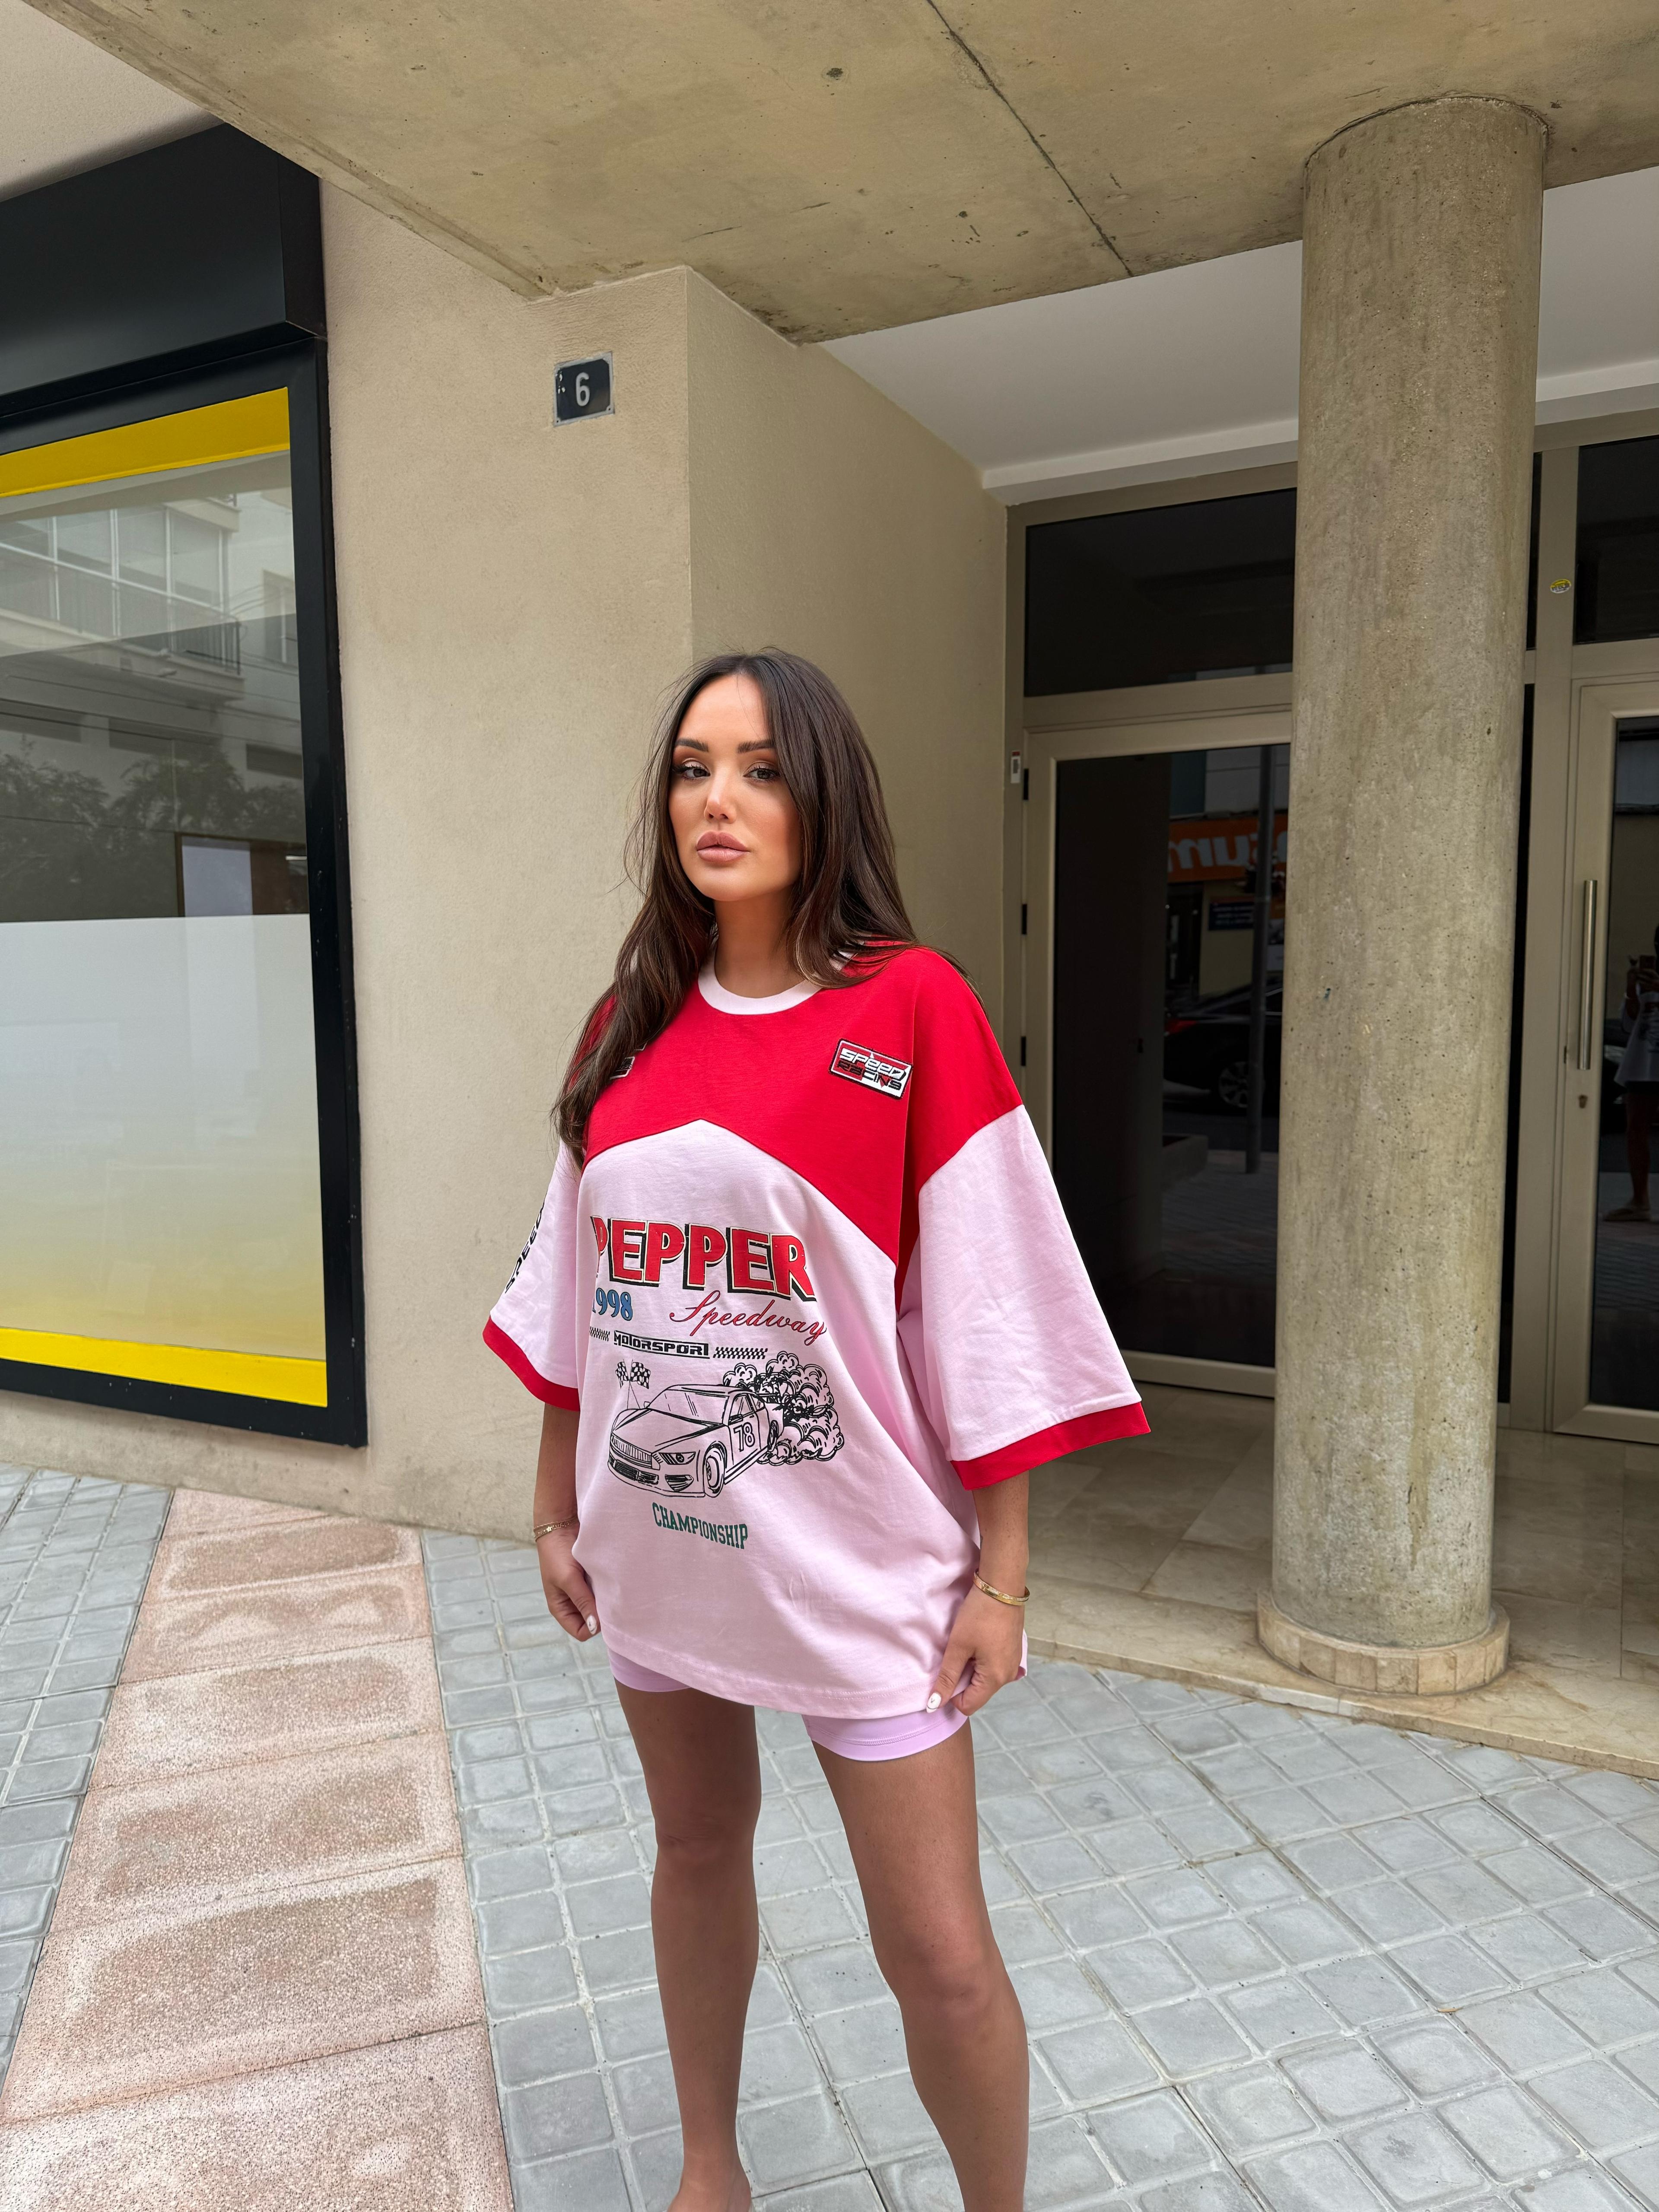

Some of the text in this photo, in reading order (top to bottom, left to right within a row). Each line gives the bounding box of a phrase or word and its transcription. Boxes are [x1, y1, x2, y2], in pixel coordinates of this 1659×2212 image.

[575, 372, 590, 407] 6
[839, 1047, 906, 1081] SPEED
[592, 1287, 633, 1321] 998
[669, 1290, 827, 1346] Speedway
[614, 1330, 709, 1356] MOTORSPORT
[733, 1421, 756, 1452] 78
[652, 1502, 748, 1550] CHAMPIONSHIP
